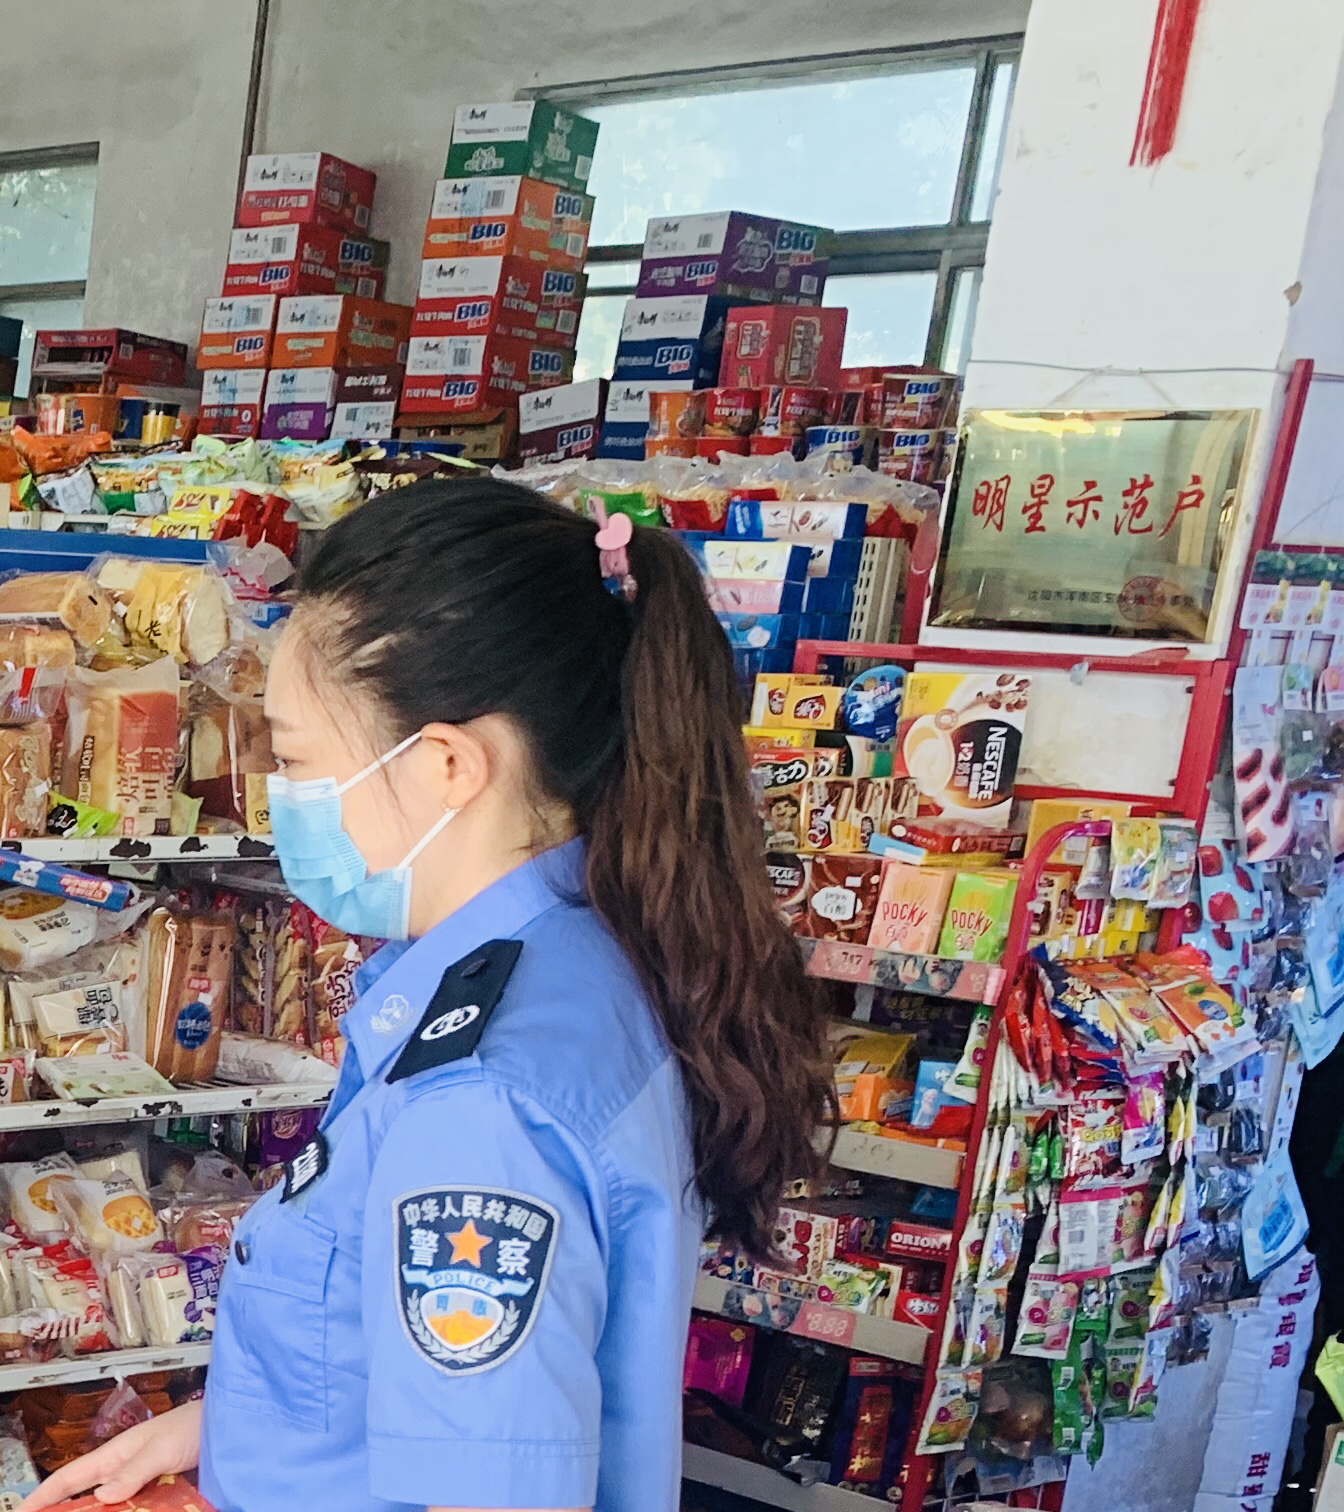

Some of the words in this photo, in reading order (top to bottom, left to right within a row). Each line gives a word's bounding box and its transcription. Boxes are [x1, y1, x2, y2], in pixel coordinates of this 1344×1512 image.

[972, 474, 1205, 540] 明星示范户
[882, 901, 928, 926] POCKY
[951, 909, 993, 937] POCKY
[403, 1195, 548, 1241] 中华人民共和国
[890, 1231, 945, 1249] ORION
[433, 1274, 496, 1291] POLICE
